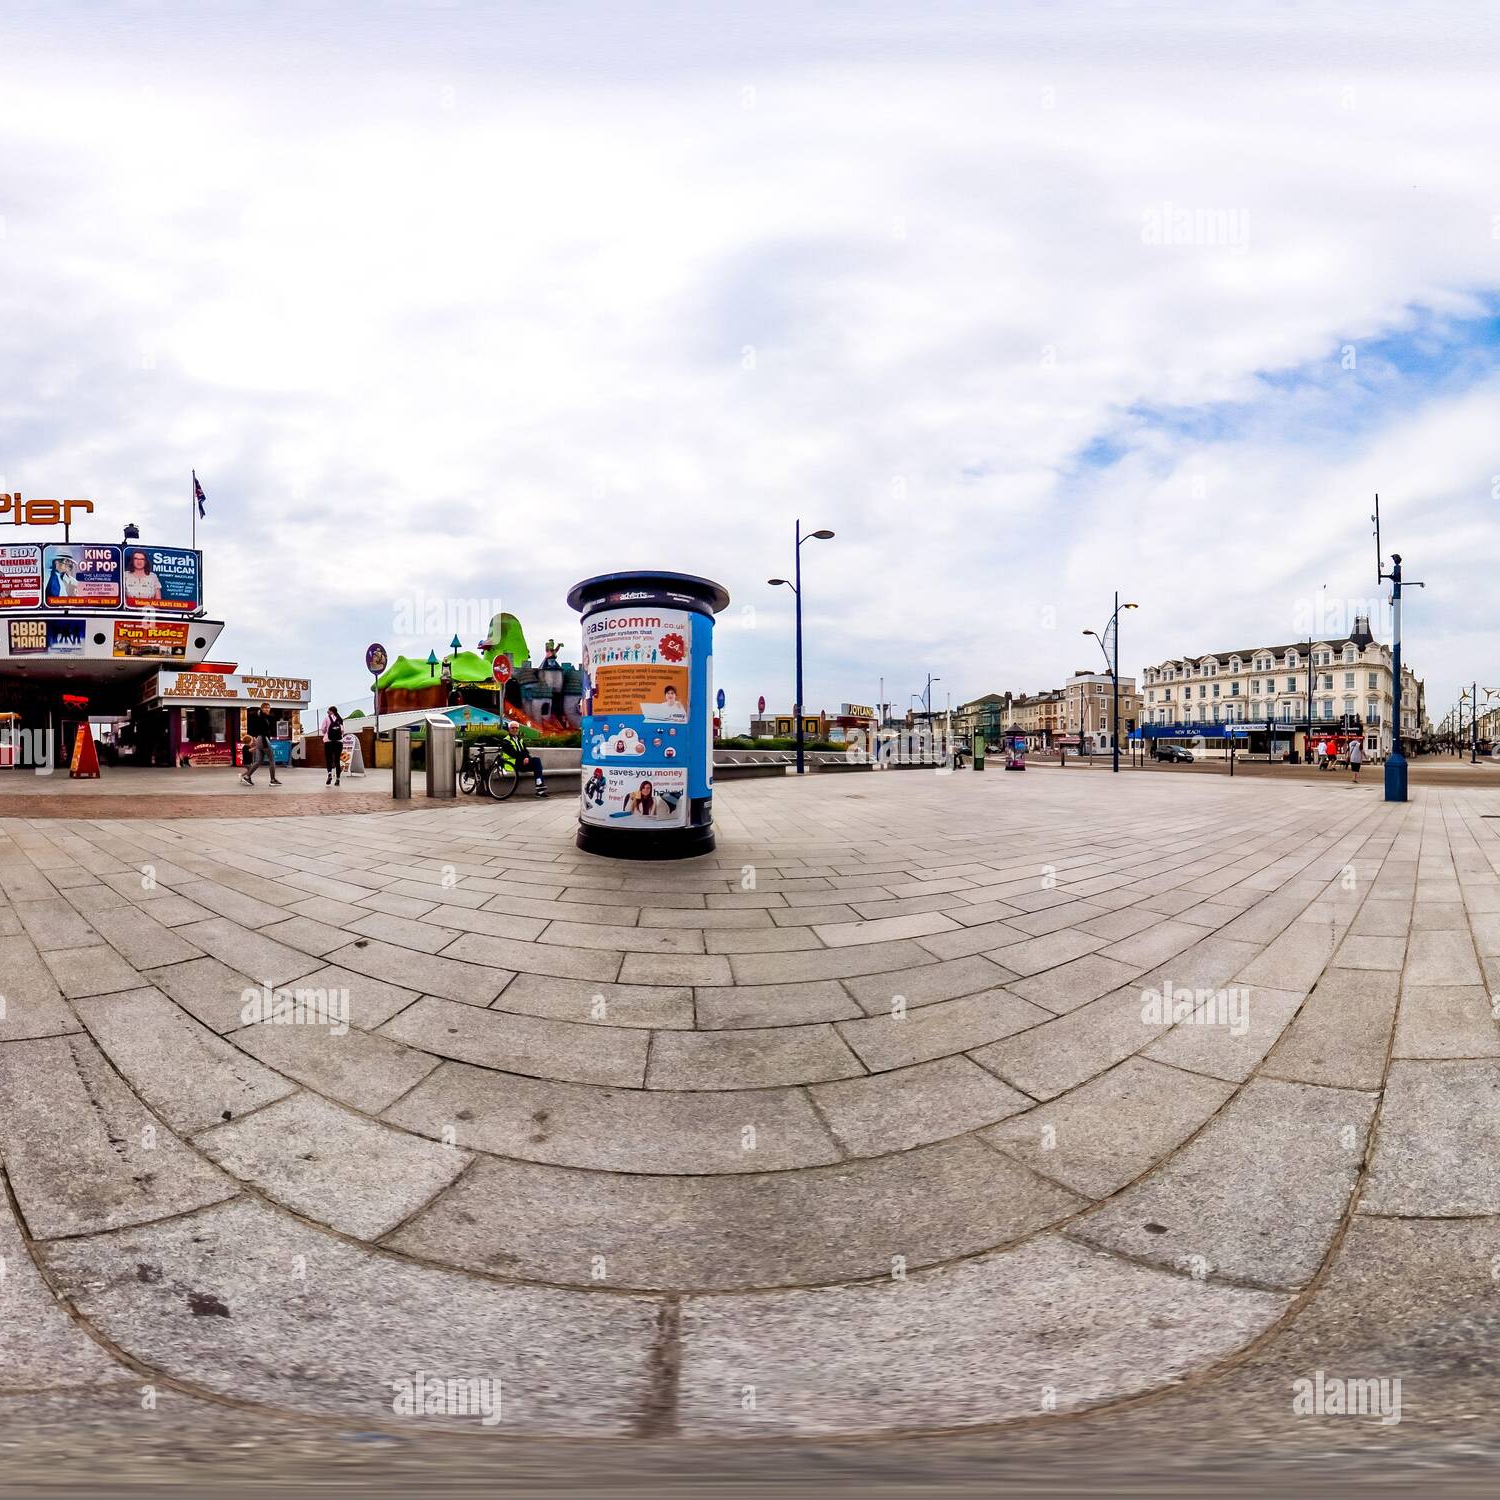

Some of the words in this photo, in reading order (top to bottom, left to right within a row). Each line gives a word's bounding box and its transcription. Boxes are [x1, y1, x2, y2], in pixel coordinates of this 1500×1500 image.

[11, 548, 36, 557] ROY
[84, 549, 112, 559] KING
[153, 553, 194, 566] Sarah
[80, 563, 94, 572] OF
[96, 562, 117, 572] POP
[153, 565, 195, 574] MILLICAN
[11, 622, 46, 635] ABBA
[119, 629, 143, 637] Fun
[148, 629, 184, 638] Rides
[12, 636, 46, 648] MANIA
[178, 673, 223, 682] BURGERS
[176, 681, 197, 689] HOT
[199, 681, 226, 690] DOGS
[257, 678, 308, 690] DONUTS
[164, 688, 195, 696] JACKET
[197, 689, 237, 697] POTATOES
[247, 688, 301, 699] WAFFLES
[636, 770, 652, 778] you
